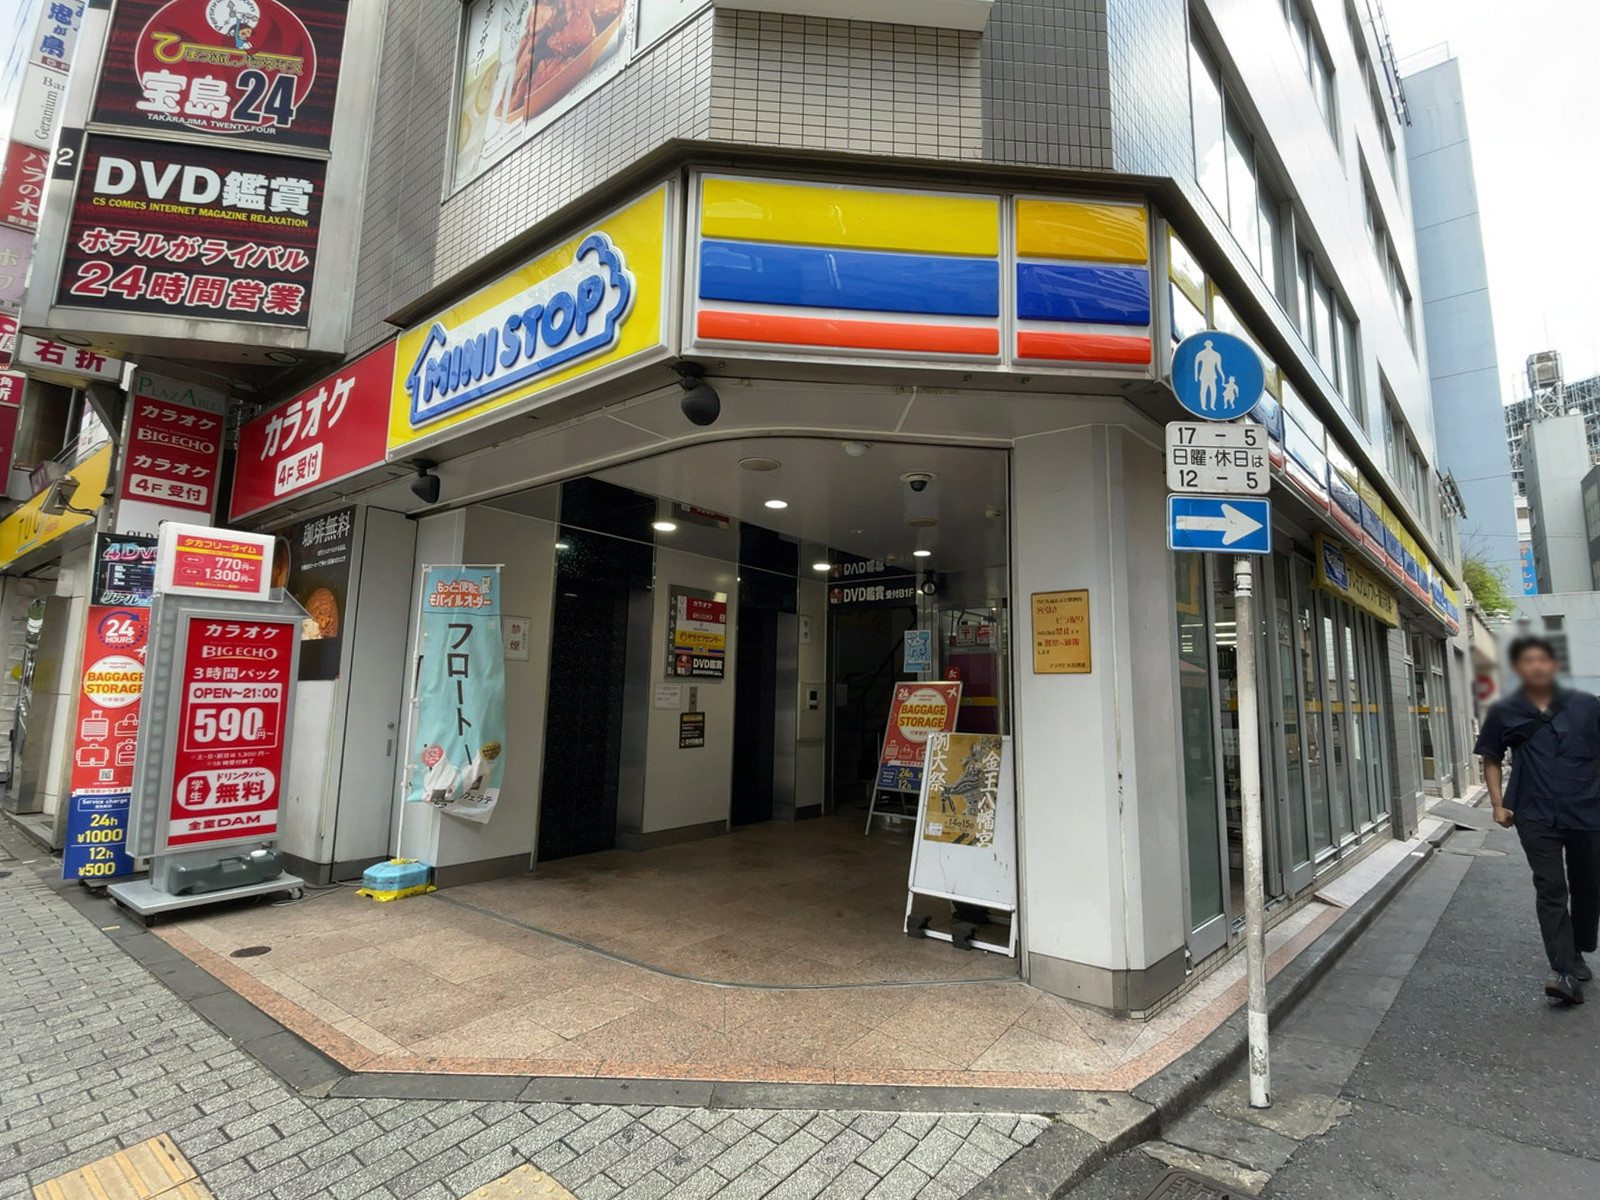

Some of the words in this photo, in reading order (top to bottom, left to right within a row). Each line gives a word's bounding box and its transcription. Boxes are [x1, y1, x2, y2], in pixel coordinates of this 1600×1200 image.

[136, 69, 297, 128] 宝島24
[34, 90, 59, 140] Geranium
[147, 112, 206, 127] TAKARAJIMA
[210, 120, 249, 131] TWENTY
[251, 126, 276, 135] FOUR
[57, 148, 74, 166] 2
[94, 156, 314, 216] DVD鑑賞
[93, 197, 106, 206] CS
[109, 198, 147, 210] COMICS
[150, 203, 196, 215] INTERNET
[199, 208, 248, 221] MAGAZINE
[250, 213, 309, 227] RELAXATION
[79, 227, 309, 273] ホテルがライバル
[71, 260, 304, 315] 24時間営業
[140, 404, 217, 431] カラオケ
[261, 376, 356, 461] カラオケ
[137, 427, 169, 444] BIG
[172, 435, 215, 455] ECHO
[1178, 427, 1196, 444] 17
[1245, 429, 1256, 446] 5
[132, 454, 211, 479] カラオケ
[1173, 448, 1264, 468] 日曜・休日は
[1179, 469, 1198, 487] 12
[1246, 472, 1258, 489] 5
[429, 594, 492, 609] モバイルオーダー
[106, 619, 135, 637] 24
[204, 624, 280, 639] カラオケ
[105, 636, 135, 644] HOURS
[201, 645, 233, 658] BIG
[235, 647, 278, 660] ECHO
[87, 672, 144, 682] BAGGAGE
[193, 667, 280, 680] 3時間パック
[86, 683, 143, 694] STORAGE
[901, 704, 946, 716] BAGGAGE
[899, 716, 945, 728] STORAGE
[216, 771, 266, 781] ドリンクバー
[189, 779, 204, 802] 学生
[215, 780, 265, 804] 無料
[90, 814, 118, 827] 24h
[188, 814, 261, 831] 全室DAM
[77, 828, 123, 843] ¥1000
[89, 847, 114, 859] 12h
[78, 862, 116, 876] ¥500
